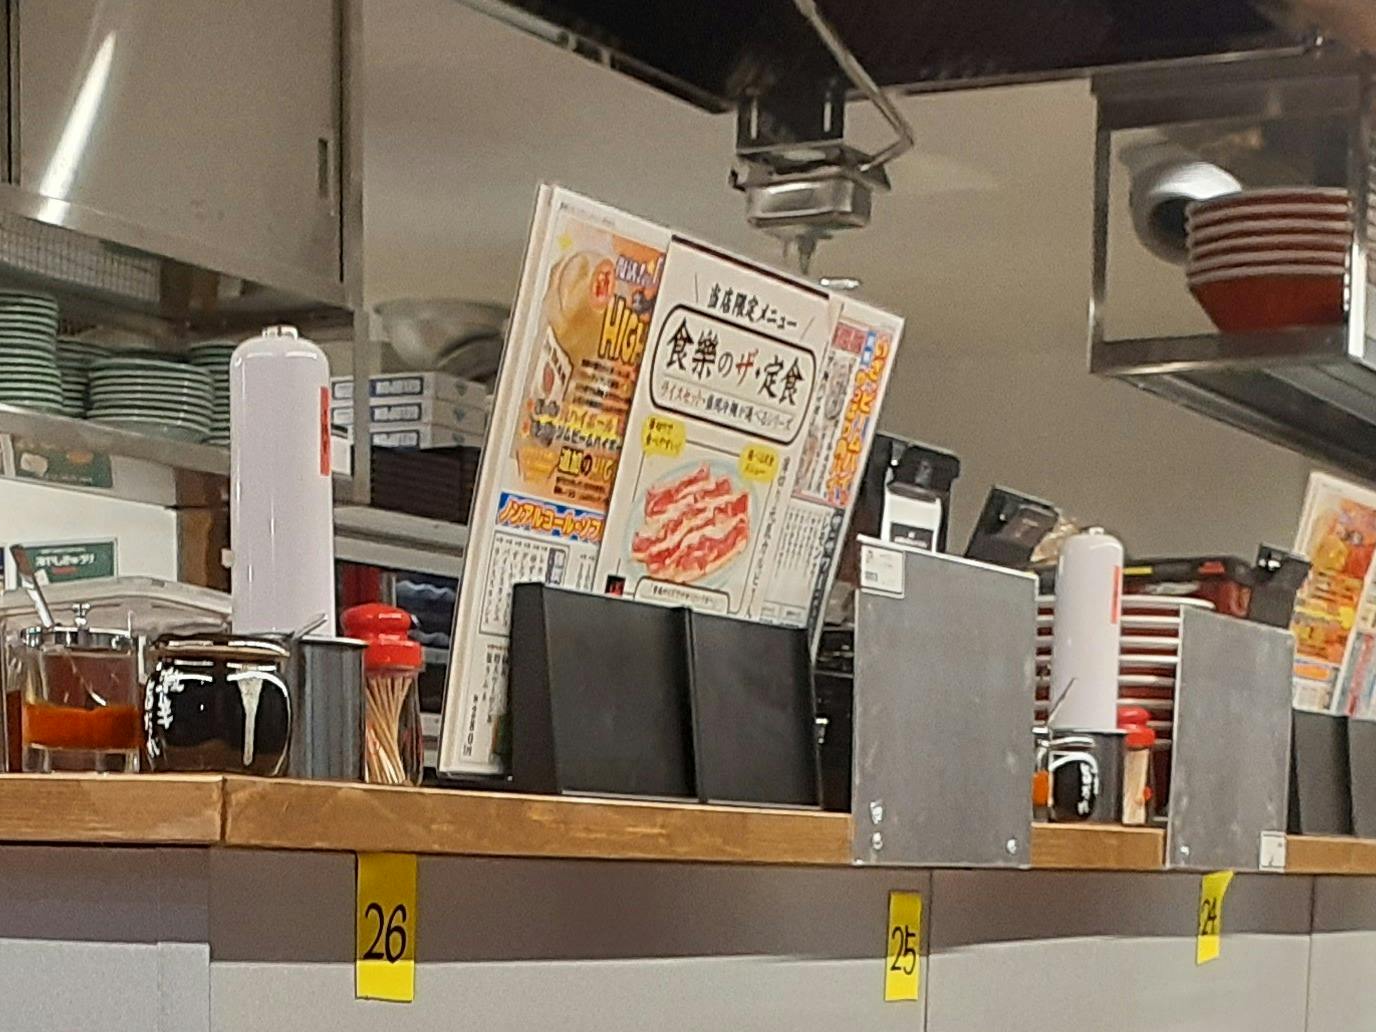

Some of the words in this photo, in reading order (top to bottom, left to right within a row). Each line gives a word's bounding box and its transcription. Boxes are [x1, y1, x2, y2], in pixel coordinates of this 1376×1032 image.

[707, 282, 797, 330] 当店限定メニュー
[362, 902, 407, 964] 26
[890, 925, 917, 975] 25
